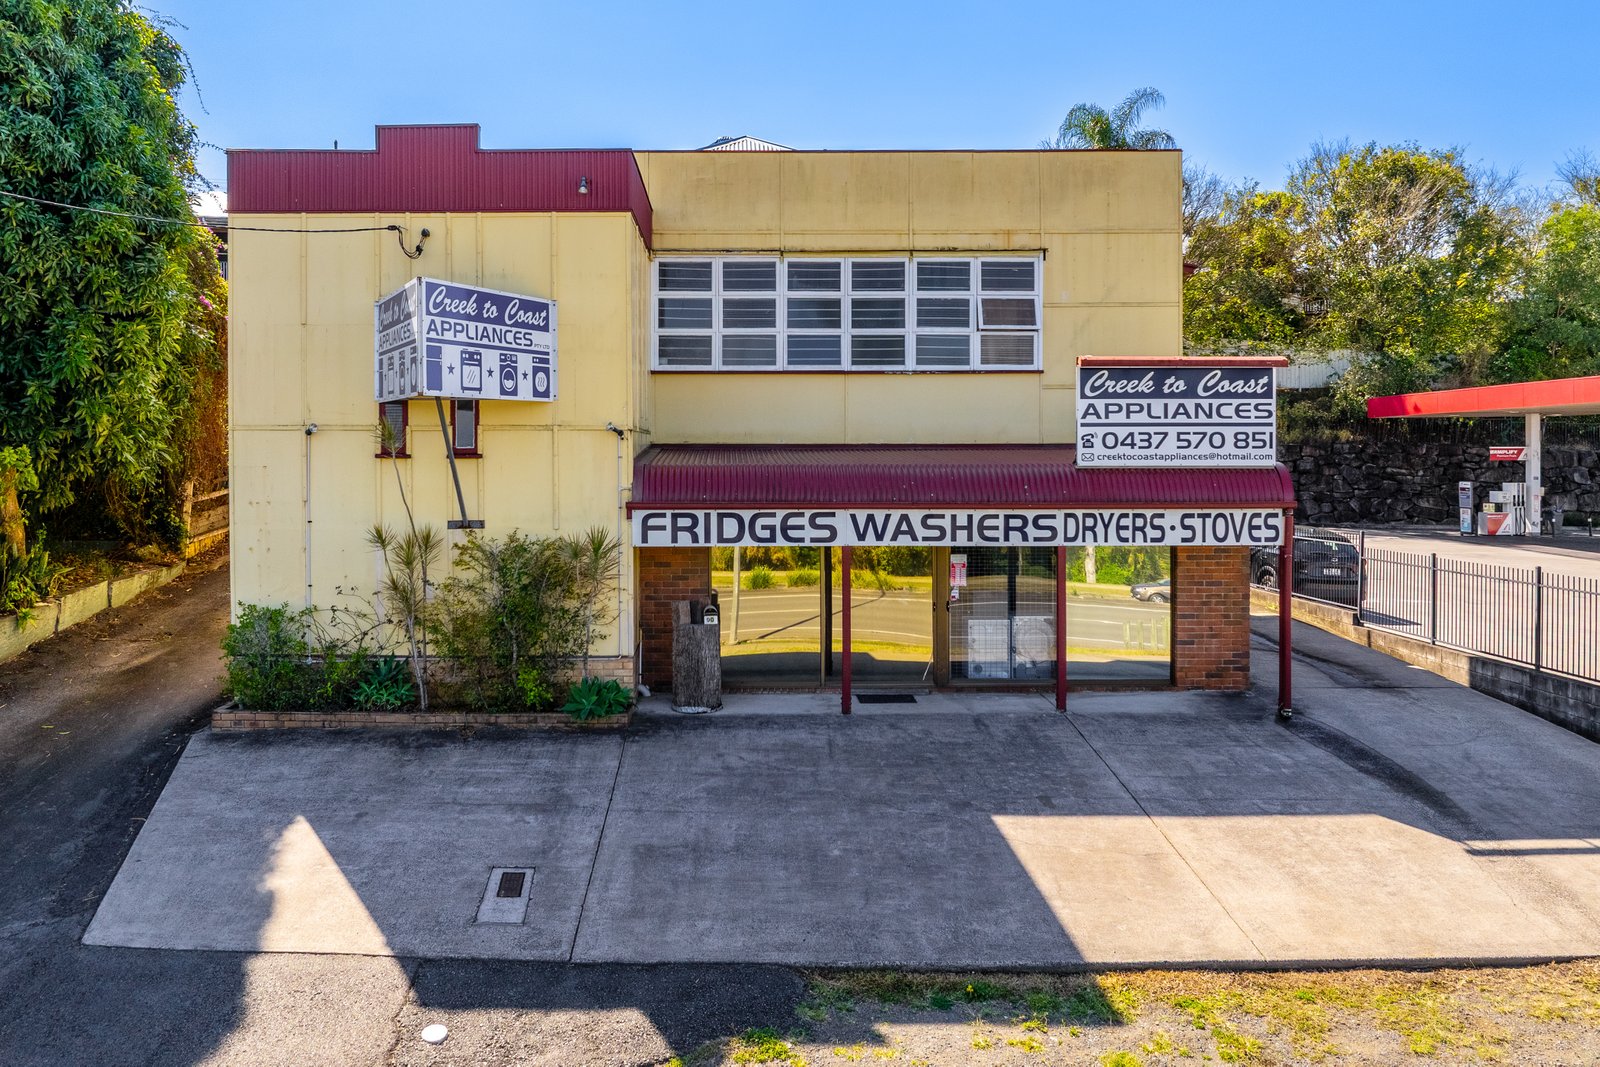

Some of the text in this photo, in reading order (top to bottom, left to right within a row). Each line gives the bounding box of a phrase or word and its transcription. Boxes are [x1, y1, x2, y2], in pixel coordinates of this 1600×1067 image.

[428, 286, 547, 327] Creek to Coast
[379, 322, 411, 350] APPLIANCES
[426, 318, 533, 347] APPLIANCES
[1084, 369, 1269, 397] Creek to Coast
[1080, 402, 1273, 420] APPLIANCES
[1101, 431, 1273, 450] 0437 570 851
[1097, 452, 1273, 462] creektocoastappliances@hotmail.com
[640, 511, 838, 544] FRIDGES
[849, 513, 1059, 543] WASHERS
[1063, 512, 1280, 543] DRYERS STOVES
